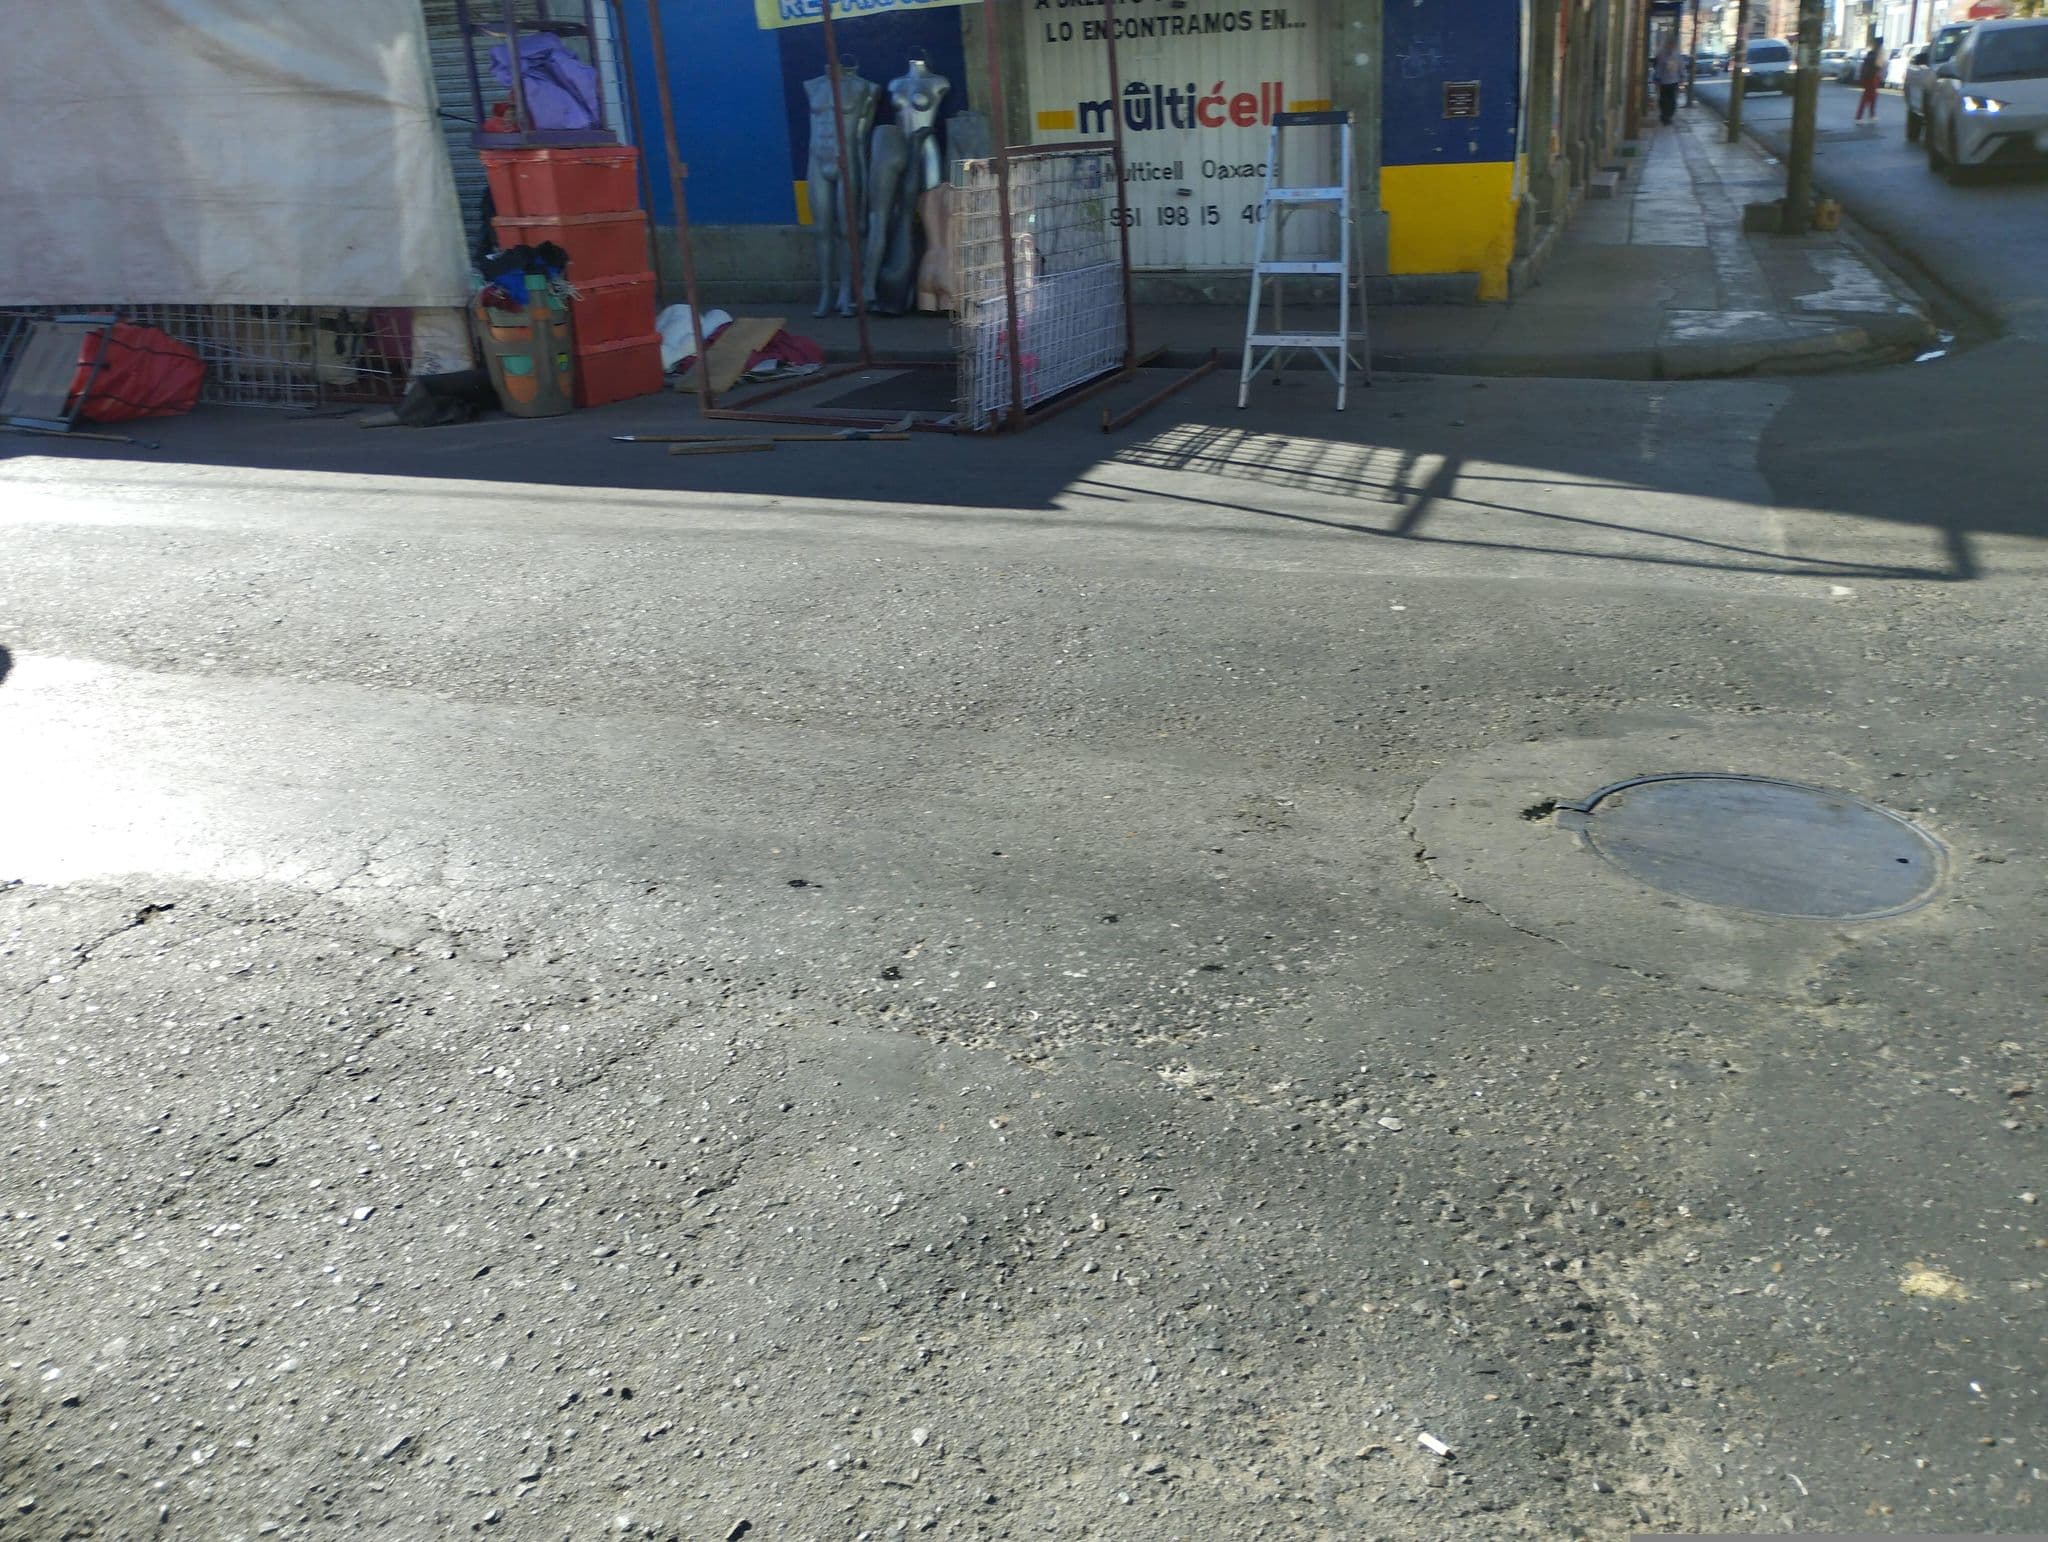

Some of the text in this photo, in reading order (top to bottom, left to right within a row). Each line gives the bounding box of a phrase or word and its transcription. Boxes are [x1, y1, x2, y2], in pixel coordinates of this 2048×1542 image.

[1046, 21, 1073, 43] LO
[1082, 10, 1252, 41] ENCONTRAMOS
[1157, 206, 1190, 226] 198
